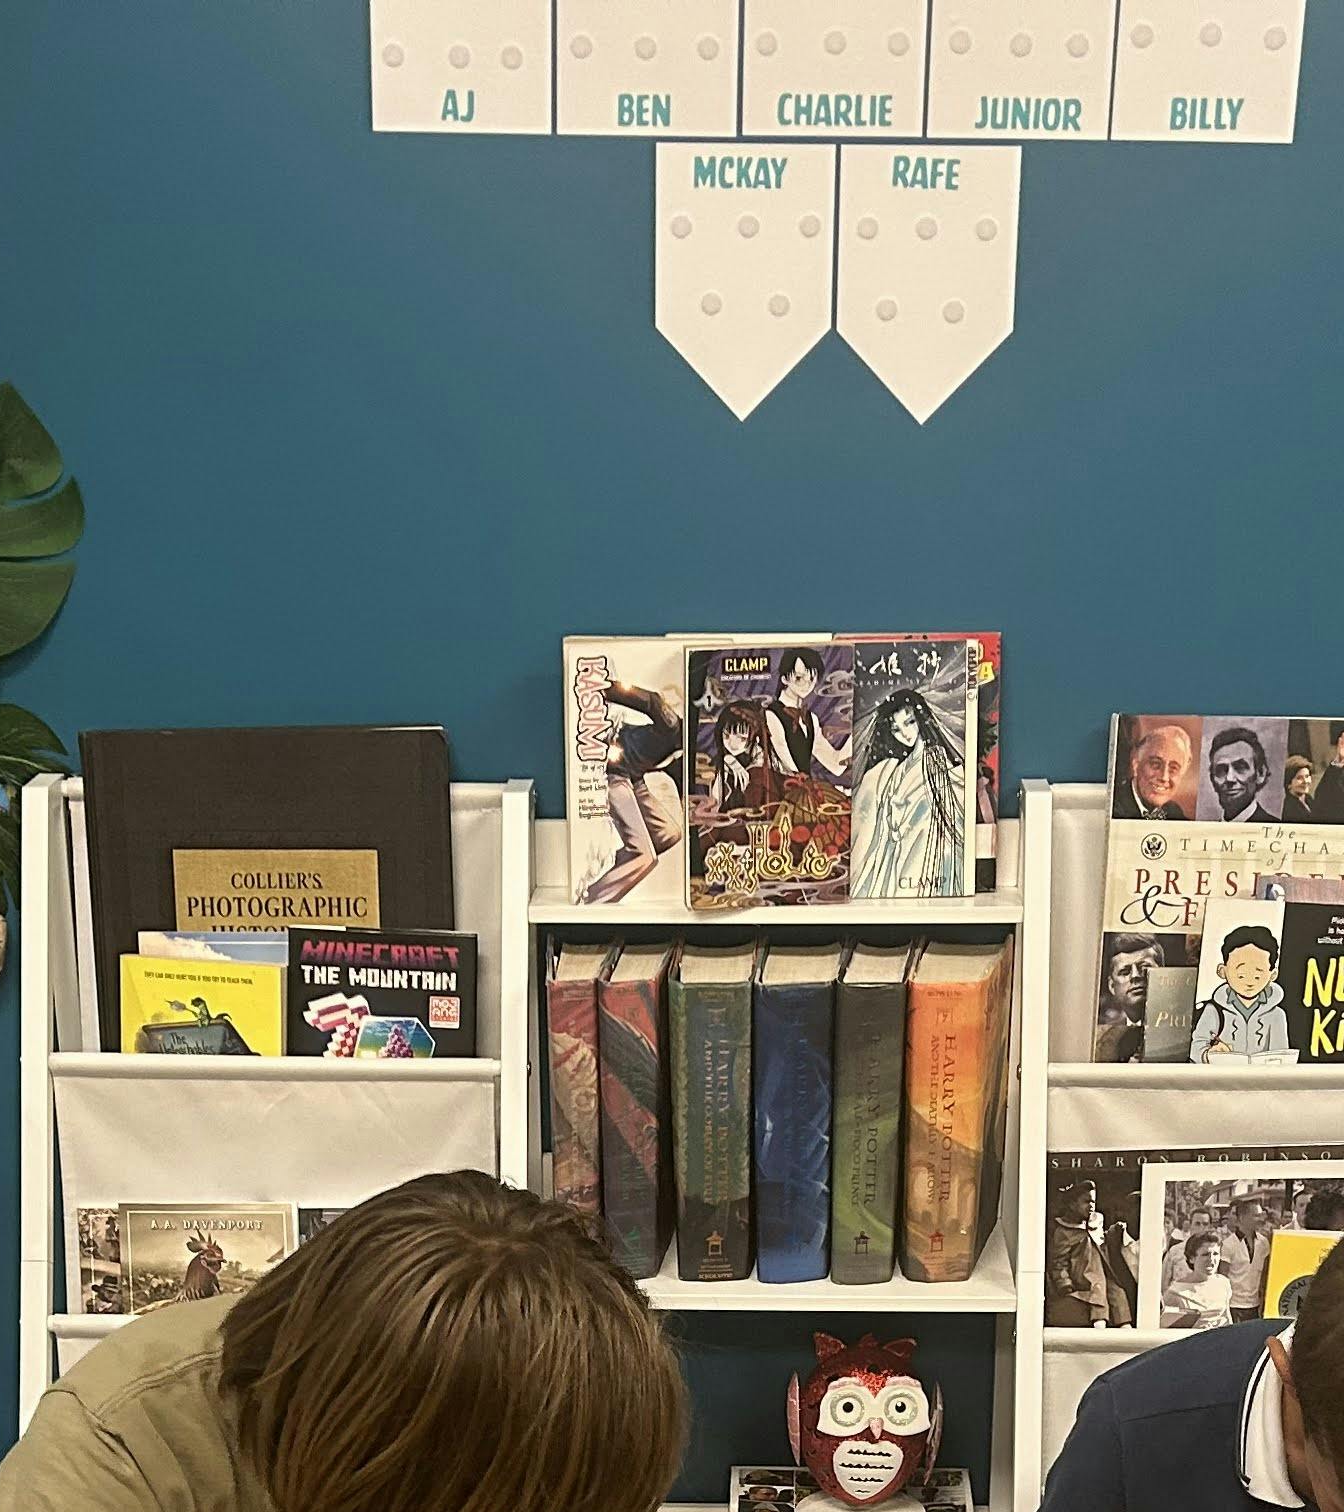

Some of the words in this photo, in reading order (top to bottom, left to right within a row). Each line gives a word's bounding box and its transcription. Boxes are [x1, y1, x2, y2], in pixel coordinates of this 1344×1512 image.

[442, 91, 473, 121] AJ
[619, 95, 670, 126] BEN
[778, 94, 892, 126] CHARLIE
[976, 97, 1081, 130] JUNIOR
[1171, 98, 1243, 129] BILLY
[695, 157, 787, 188] MCKAY
[893, 157, 960, 190] RAFE
[724, 657, 768, 672] CLAMP
[575, 656, 613, 761] KASUMI
[1261, 826, 1296, 840] The
[1266, 853, 1288, 869] of
[230, 871, 323, 889] COLLIER'S
[186, 895, 368, 919] PHOTOGRAPHIC
[301, 940, 460, 968] MINECRAFT
[301, 965, 340, 985] THE
[349, 968, 457, 991] MOUNTAIN
[942, 1033, 956, 1116] HARRY
[863, 1127, 878, 1207] POTTER
[939, 1123, 953, 1201] POTTER
[1051, 1154, 1169, 1169] SHARON
[182, 1218, 265, 1231] DAVENPORT
